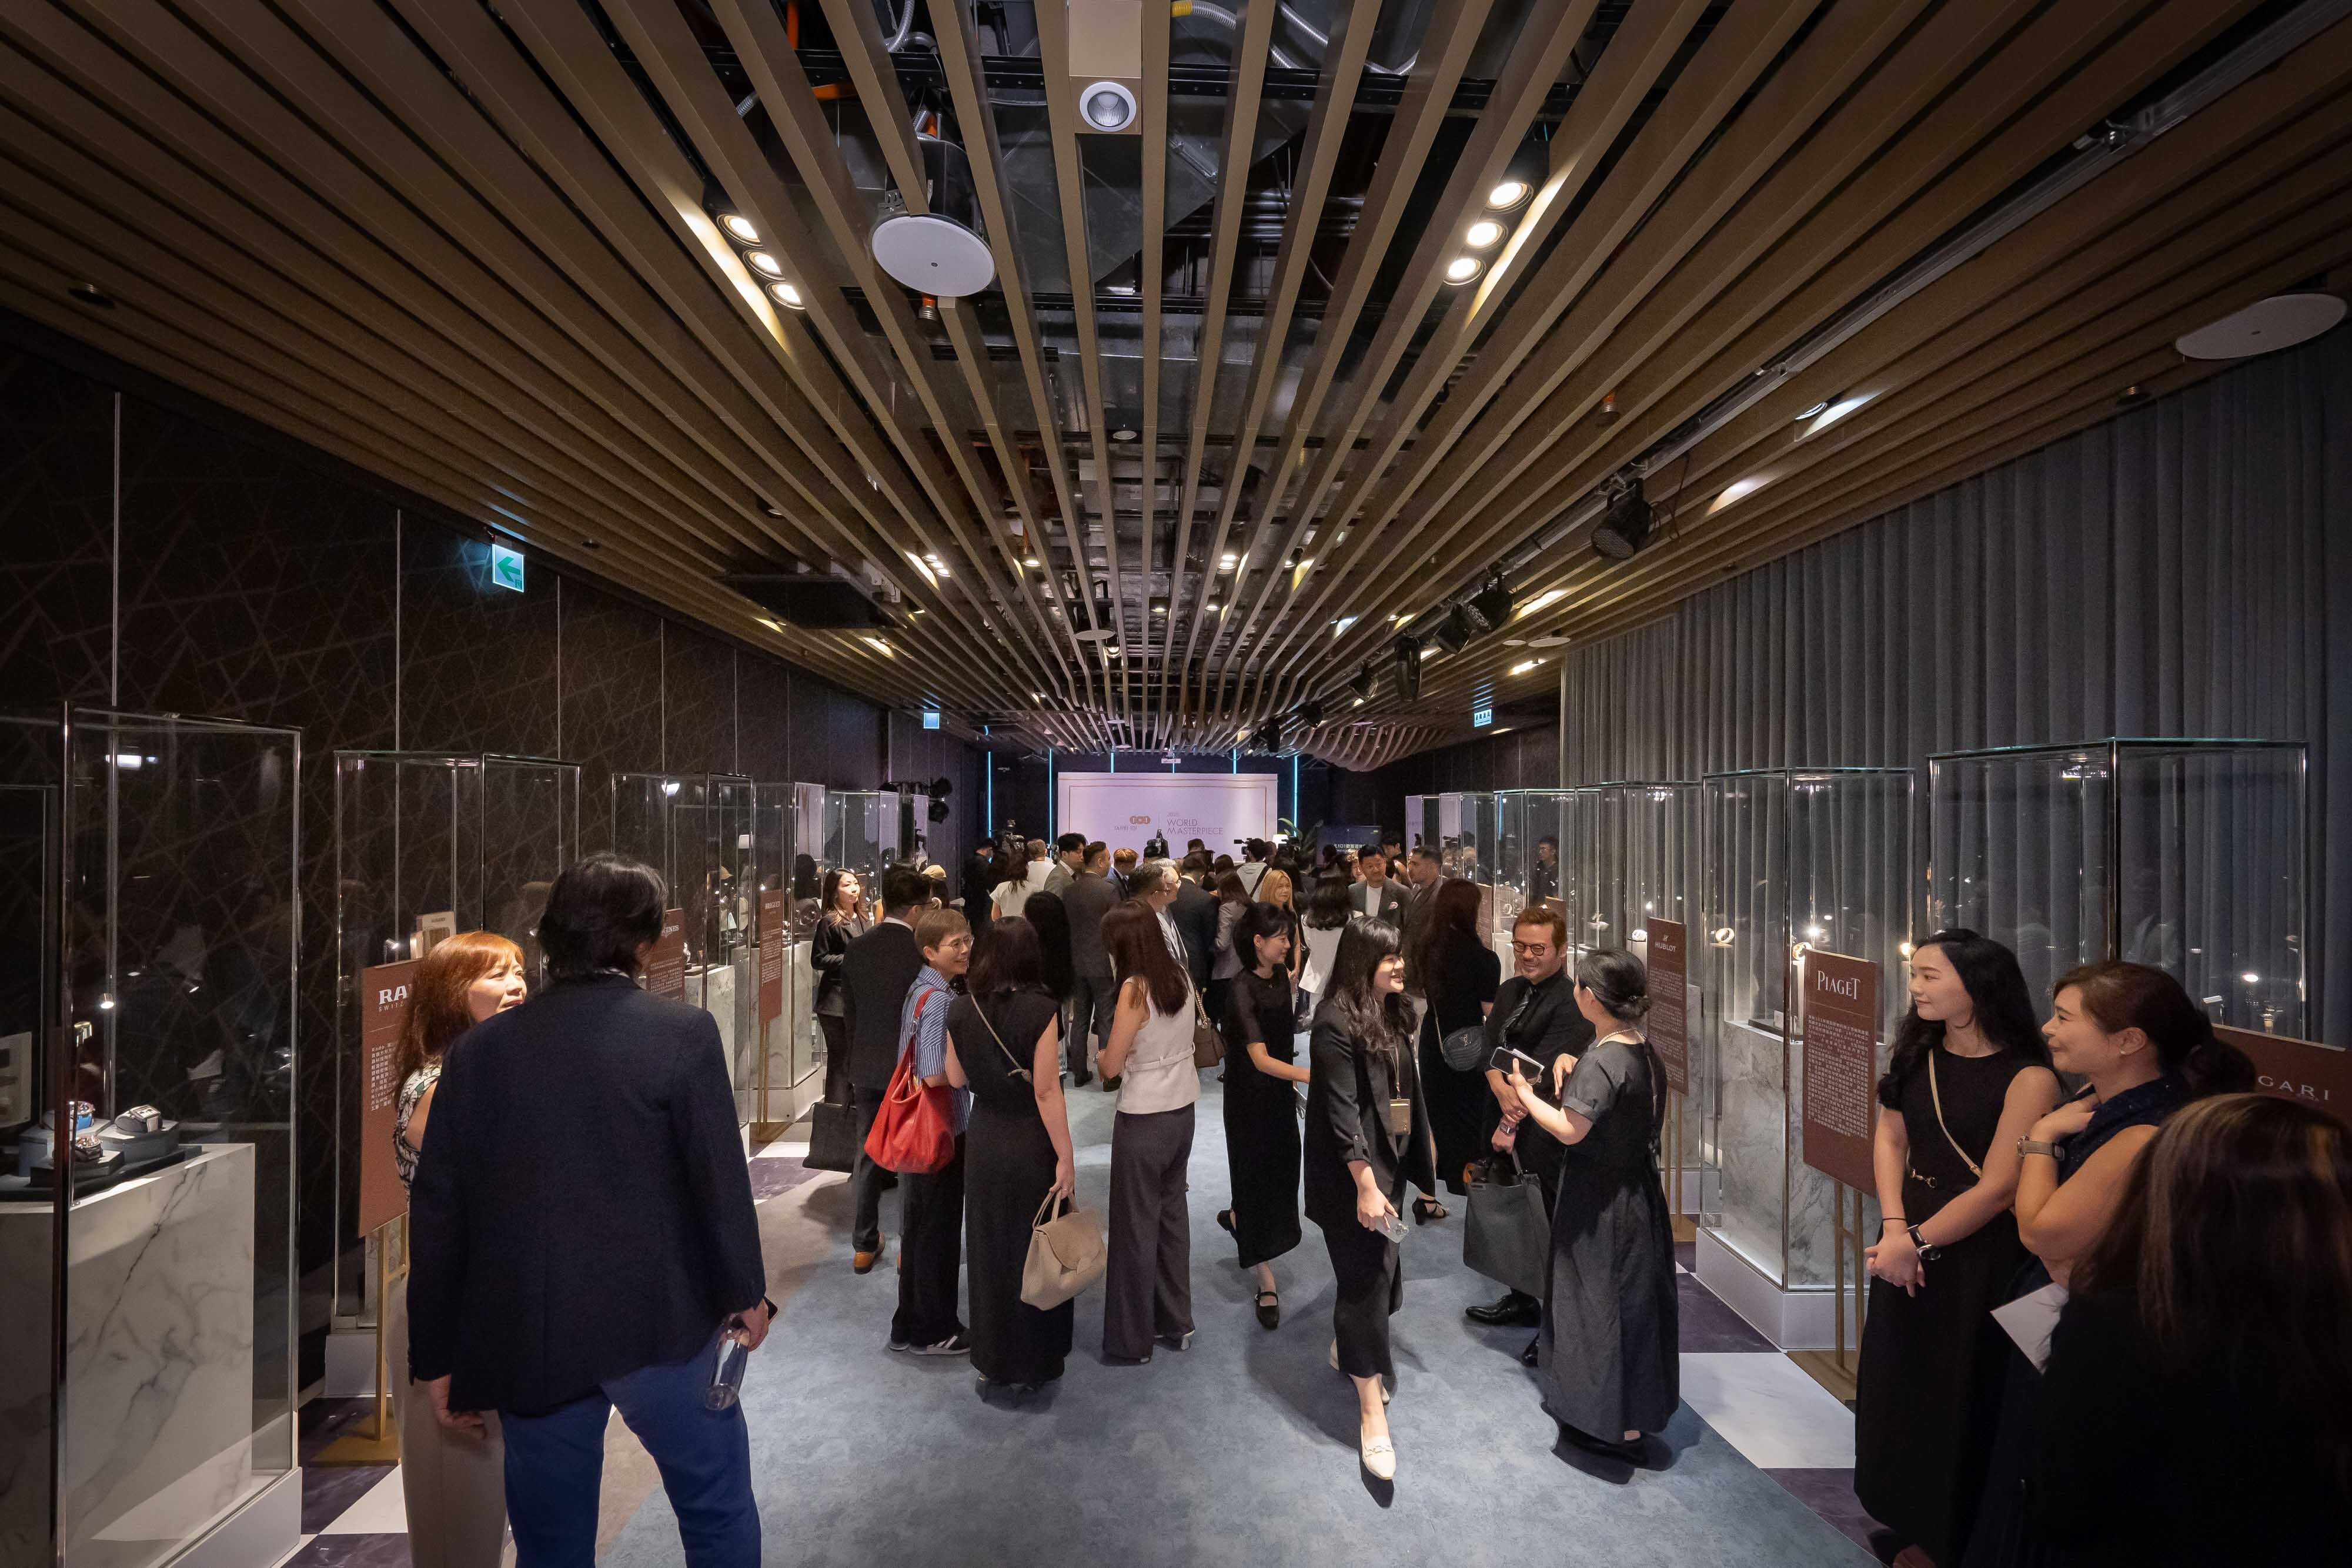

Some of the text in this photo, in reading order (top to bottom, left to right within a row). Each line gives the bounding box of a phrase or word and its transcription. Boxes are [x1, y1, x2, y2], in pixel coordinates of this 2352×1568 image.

[765, 901, 780, 910] BREGUET
[1655, 941, 1676, 952] HUBLOT
[1816, 970, 1861, 1000] PIAGET
[379, 1001, 405, 1012] SWITZ
[2257, 1076, 2329, 1101] GARI
